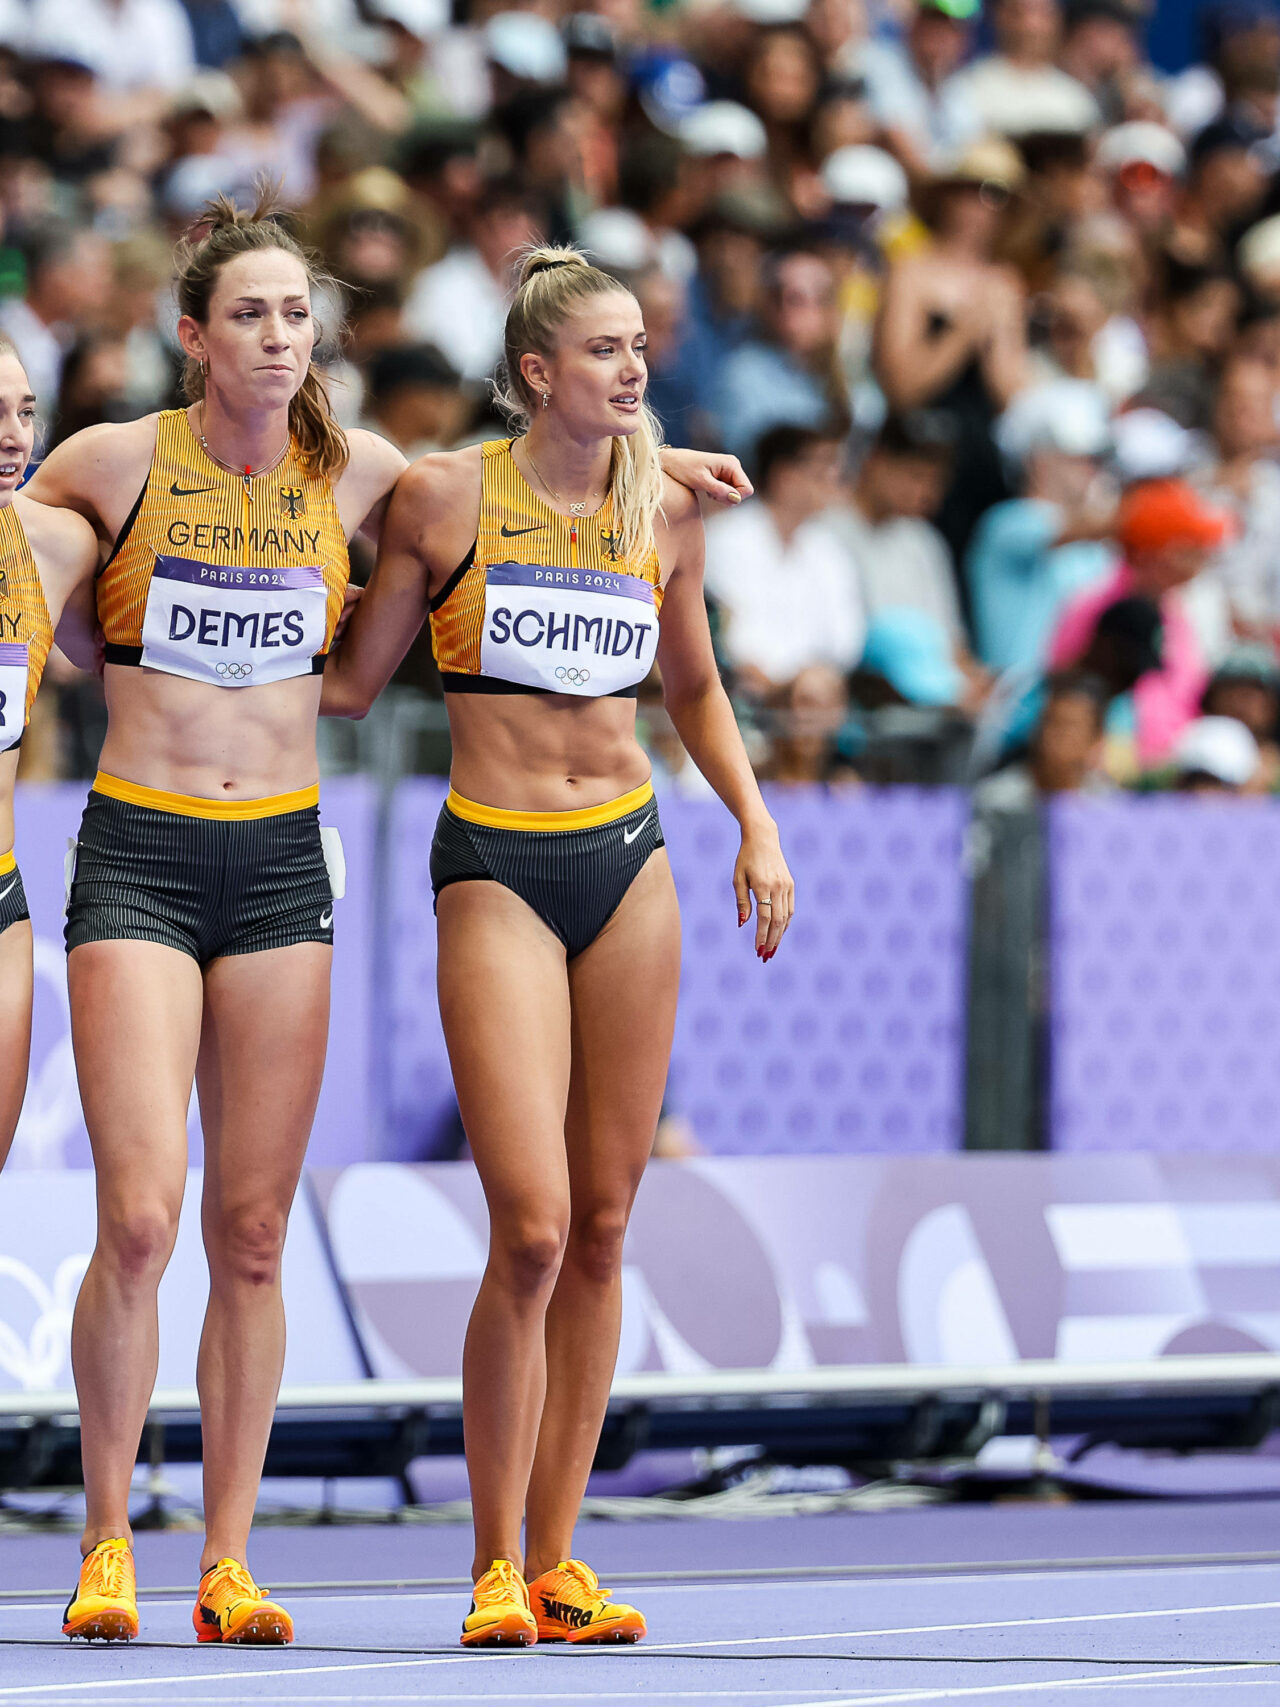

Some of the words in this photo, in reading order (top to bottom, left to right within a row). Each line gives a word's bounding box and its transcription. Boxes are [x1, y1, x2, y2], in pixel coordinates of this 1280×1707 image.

[168, 521, 320, 554] GERMANY
[200, 568, 243, 583] PARIS
[249, 573, 286, 585] 2024
[535, 570, 579, 584] PARIS
[584, 575, 620, 590] 2024
[169, 604, 304, 648] DEMES
[489, 607, 652, 660] SCHMIDT
[538, 1596, 593, 1628] NITRO
